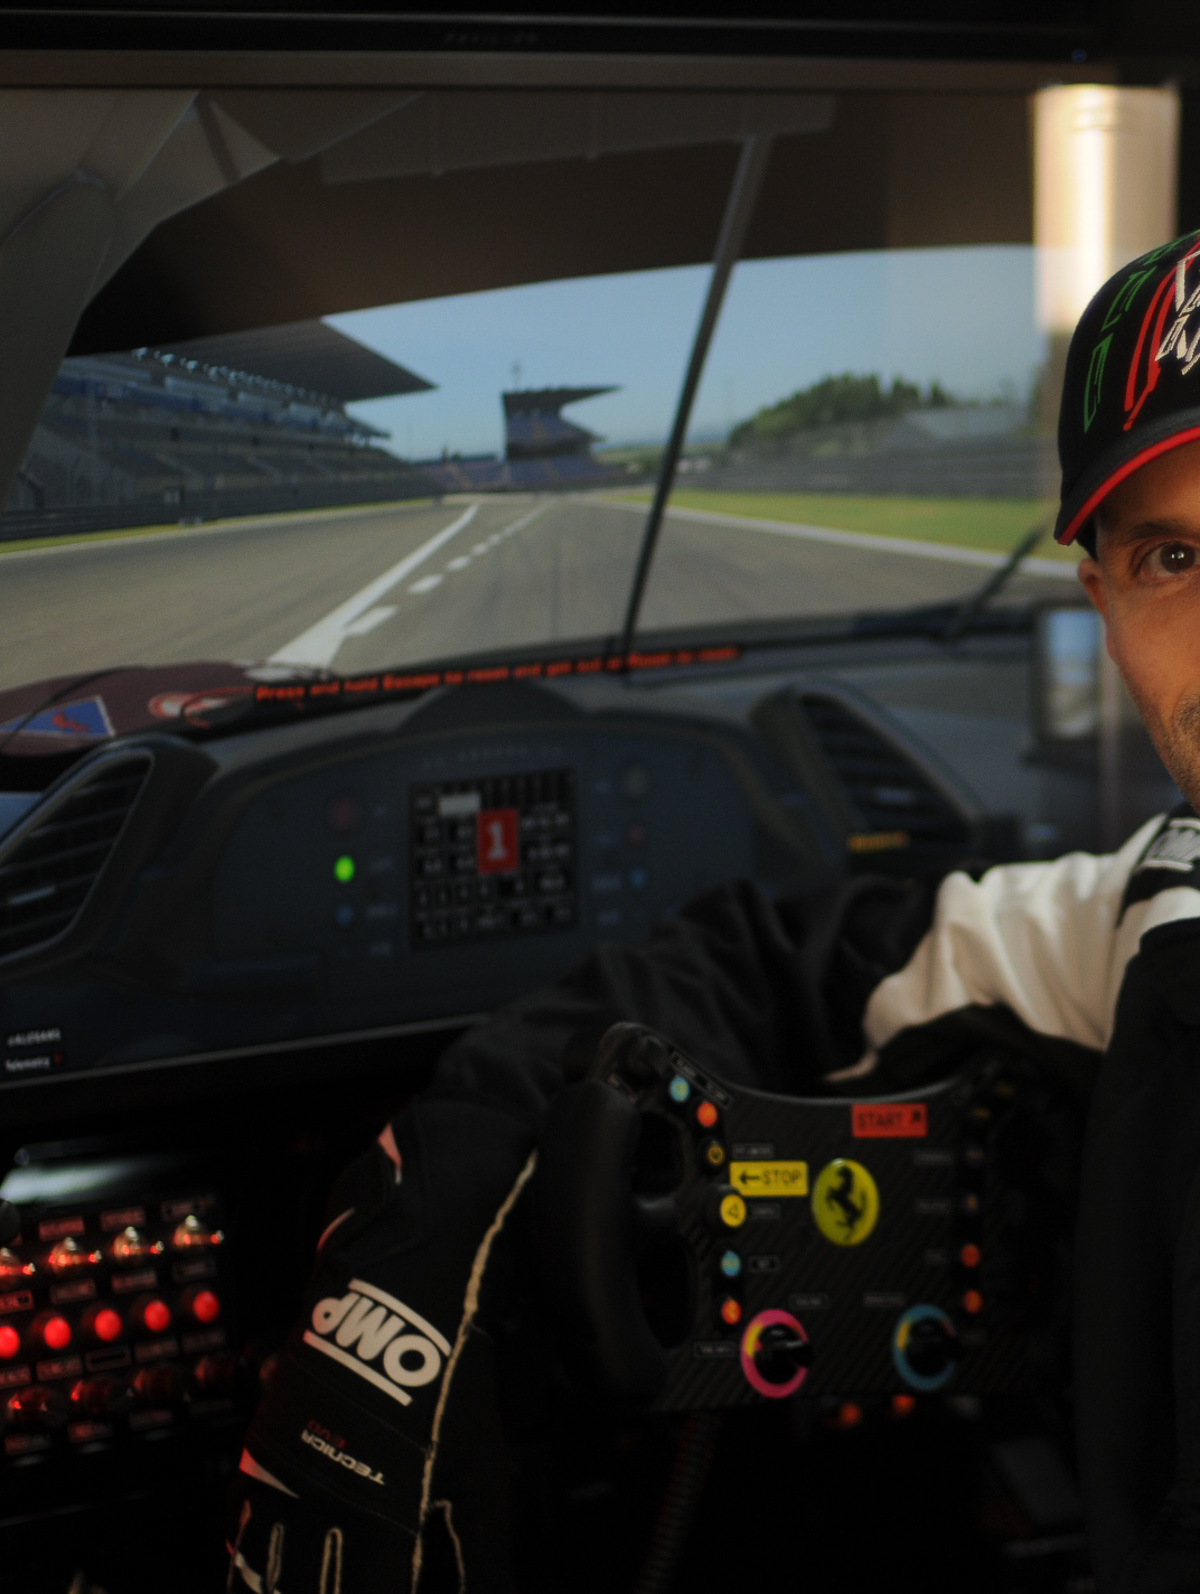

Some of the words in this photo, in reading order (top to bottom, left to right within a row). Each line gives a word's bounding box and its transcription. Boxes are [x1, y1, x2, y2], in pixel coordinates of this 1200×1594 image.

[256, 684, 305, 702] Press
[309, 680, 339, 697] and
[383, 672, 440, 691] Escape
[444, 670, 464, 686] to
[488, 820, 507, 860] 1
[857, 1111, 904, 1129] START
[762, 1169, 802, 1186] STOP
[311, 1291, 442, 1388] OMP
[300, 1428, 386, 1486] TECNICA
